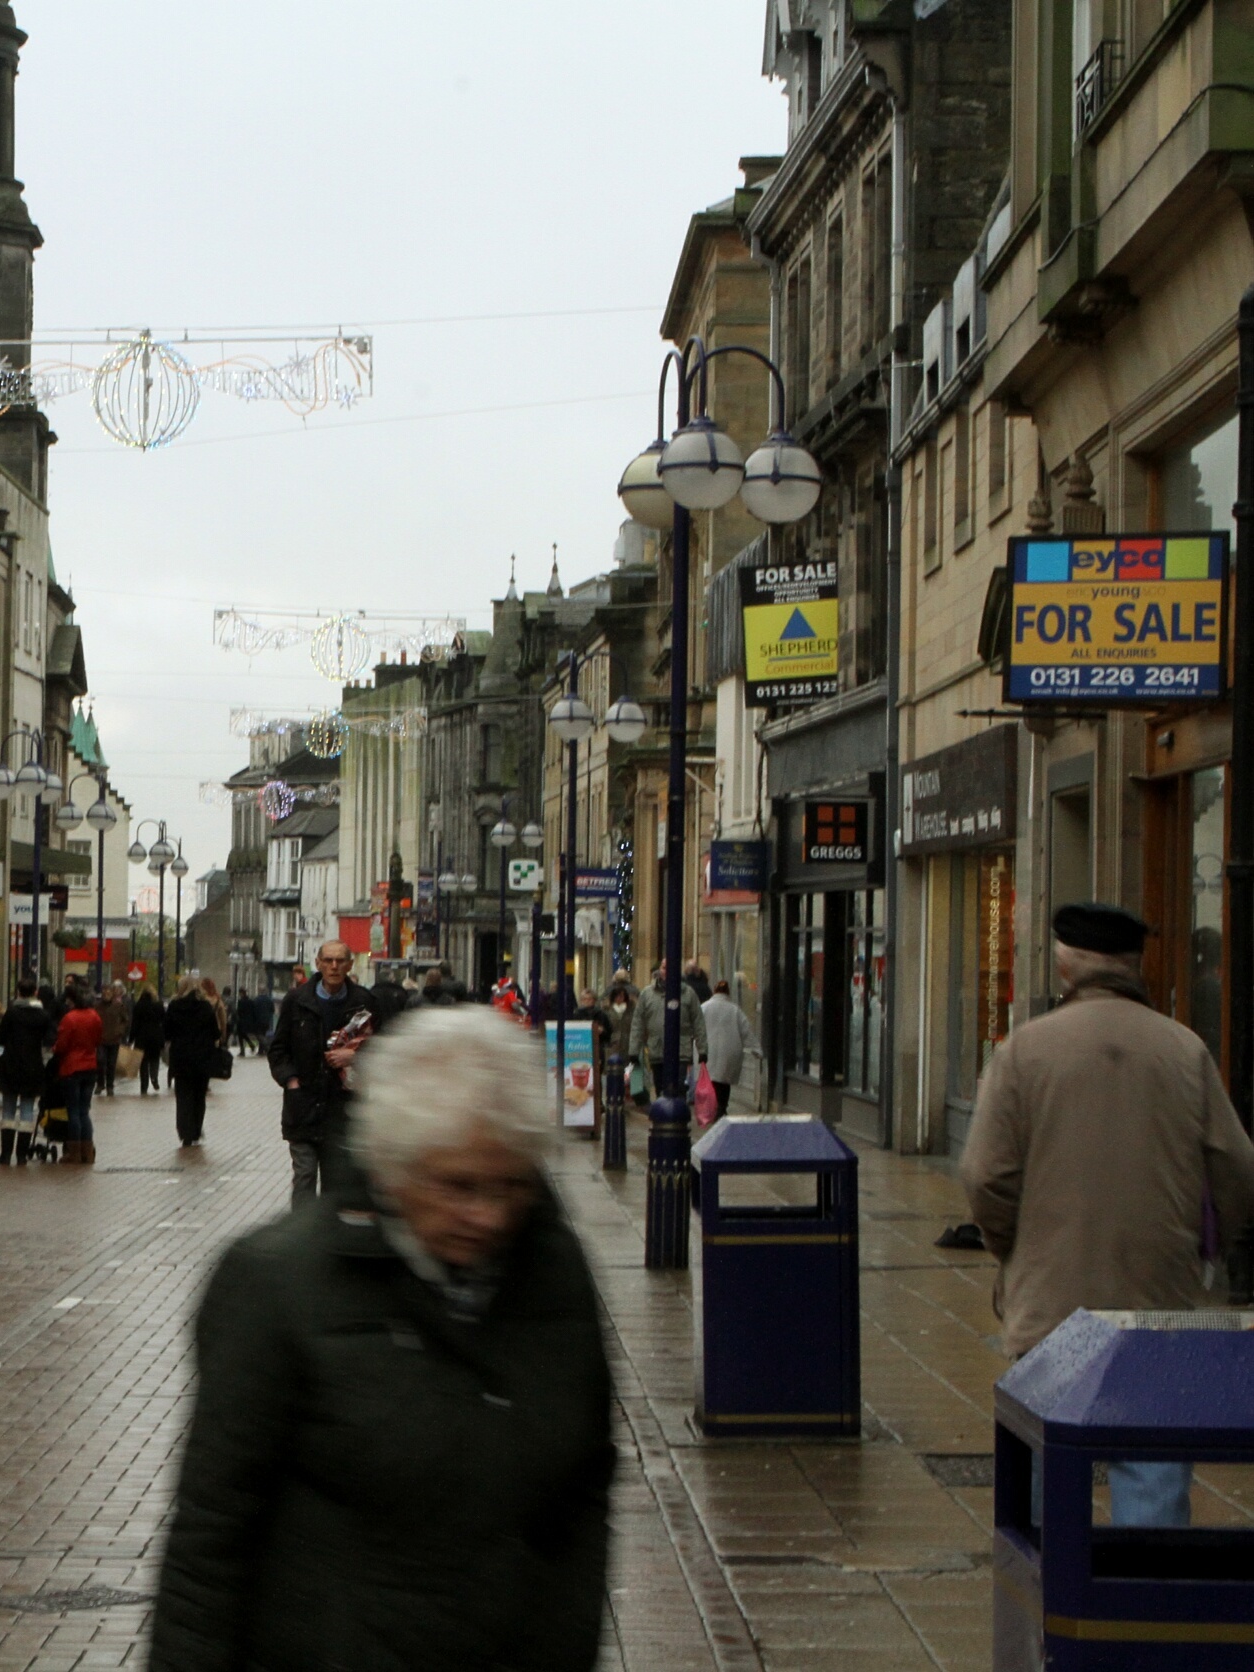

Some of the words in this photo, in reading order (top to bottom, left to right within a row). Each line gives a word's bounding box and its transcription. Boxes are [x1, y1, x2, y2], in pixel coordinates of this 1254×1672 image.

[755, 568, 790, 585] FOR
[794, 561, 837, 581] SALE
[1091, 586, 1141, 599] young
[1014, 604, 1093, 644] FOR
[1113, 602, 1217, 643] SALE
[760, 638, 838, 658] SHEPHERD
[1070, 649, 1091, 659] ALL
[1096, 647, 1157, 660] ENQUIRIES
[1030, 667, 1080, 686] 0131
[1090, 667, 1135, 686] 226
[1144, 666, 1199, 686] 2641
[756, 685, 786, 698] 0131
[789, 683, 813, 696] 225
[810, 845, 862, 859] GREGGS
[576, 877, 617, 887] BETFRED
